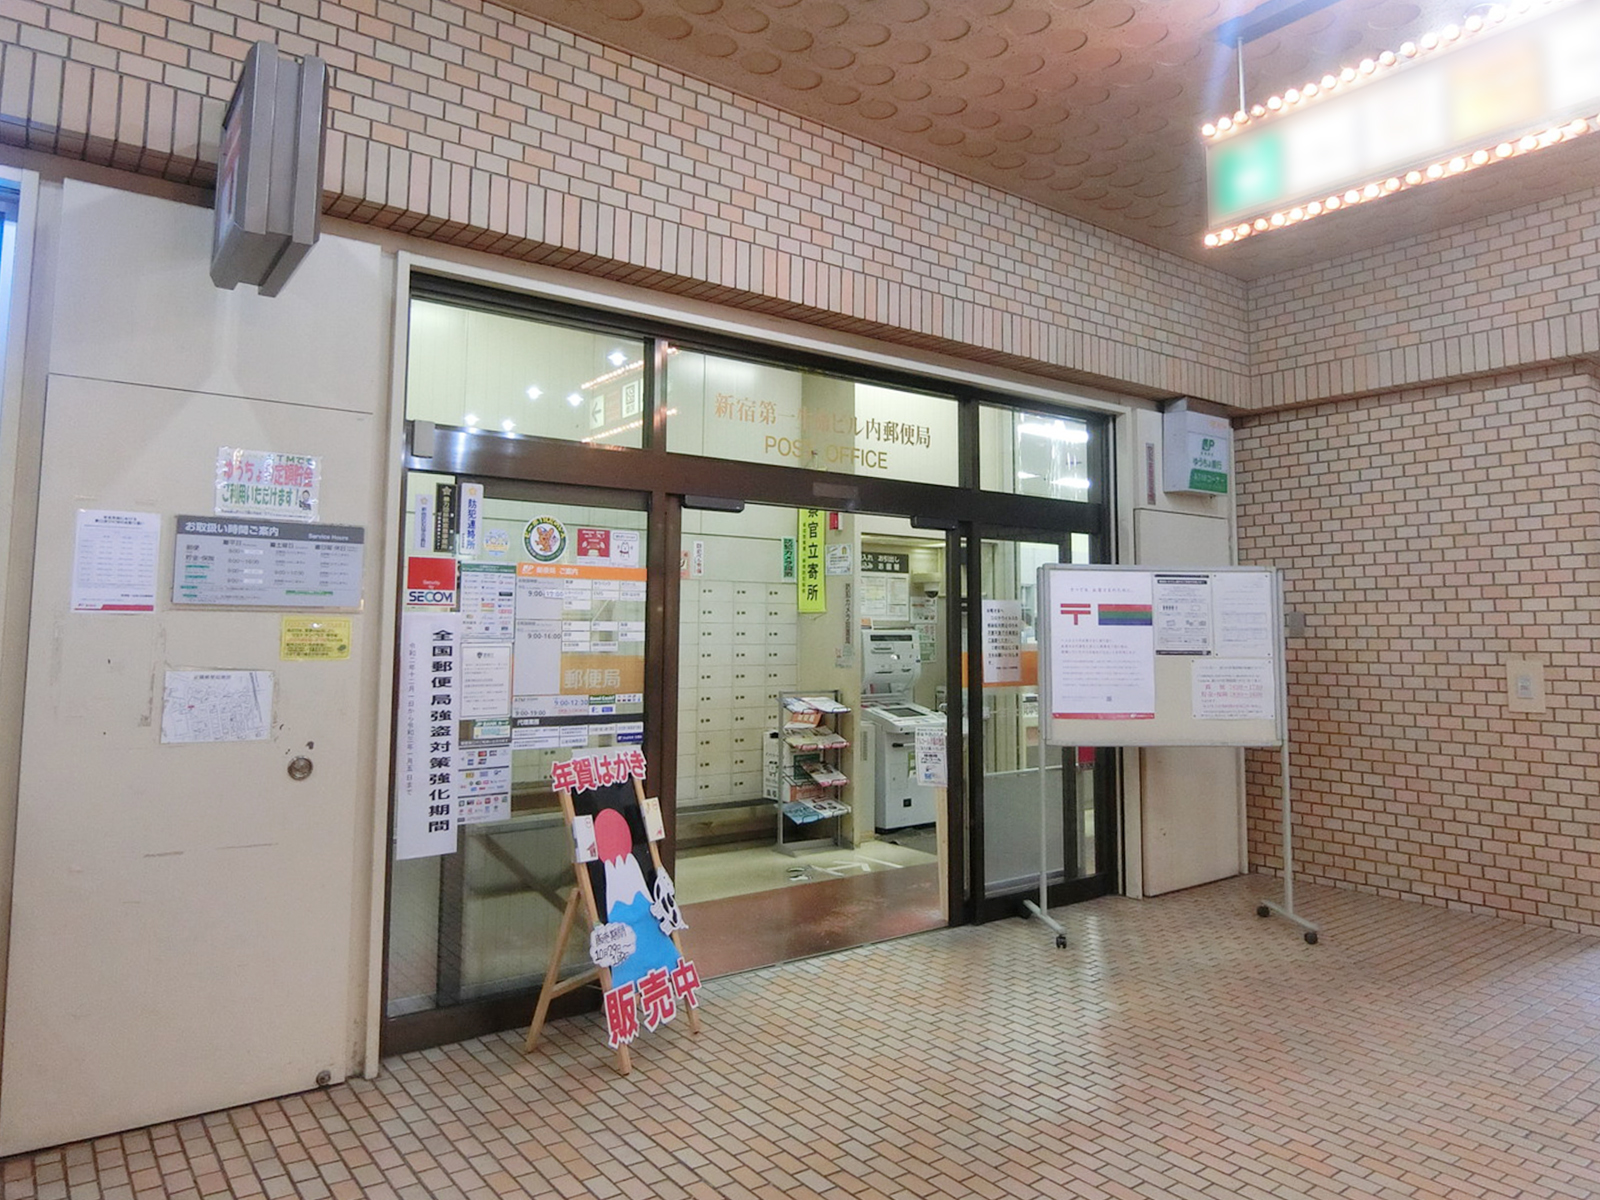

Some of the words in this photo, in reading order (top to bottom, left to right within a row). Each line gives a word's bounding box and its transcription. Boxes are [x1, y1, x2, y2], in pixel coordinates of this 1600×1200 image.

[765, 435, 815, 458] POST
[827, 444, 888, 469] OFFICE
[223, 460, 314, 488] ゆうちょ定額貯金
[185, 521, 280, 536] お取扱い時間ご案内
[465, 498, 478, 550] 防犯連絡所
[409, 591, 453, 602] SECOM
[528, 632, 562, 640] 9:00-16:00
[563, 668, 621, 689] 郵便局
[428, 629, 454, 833] 全国郵便局強盗対策強化期間
[552, 751, 646, 793] 年賀はがき
[605, 960, 700, 1045] 販売中
